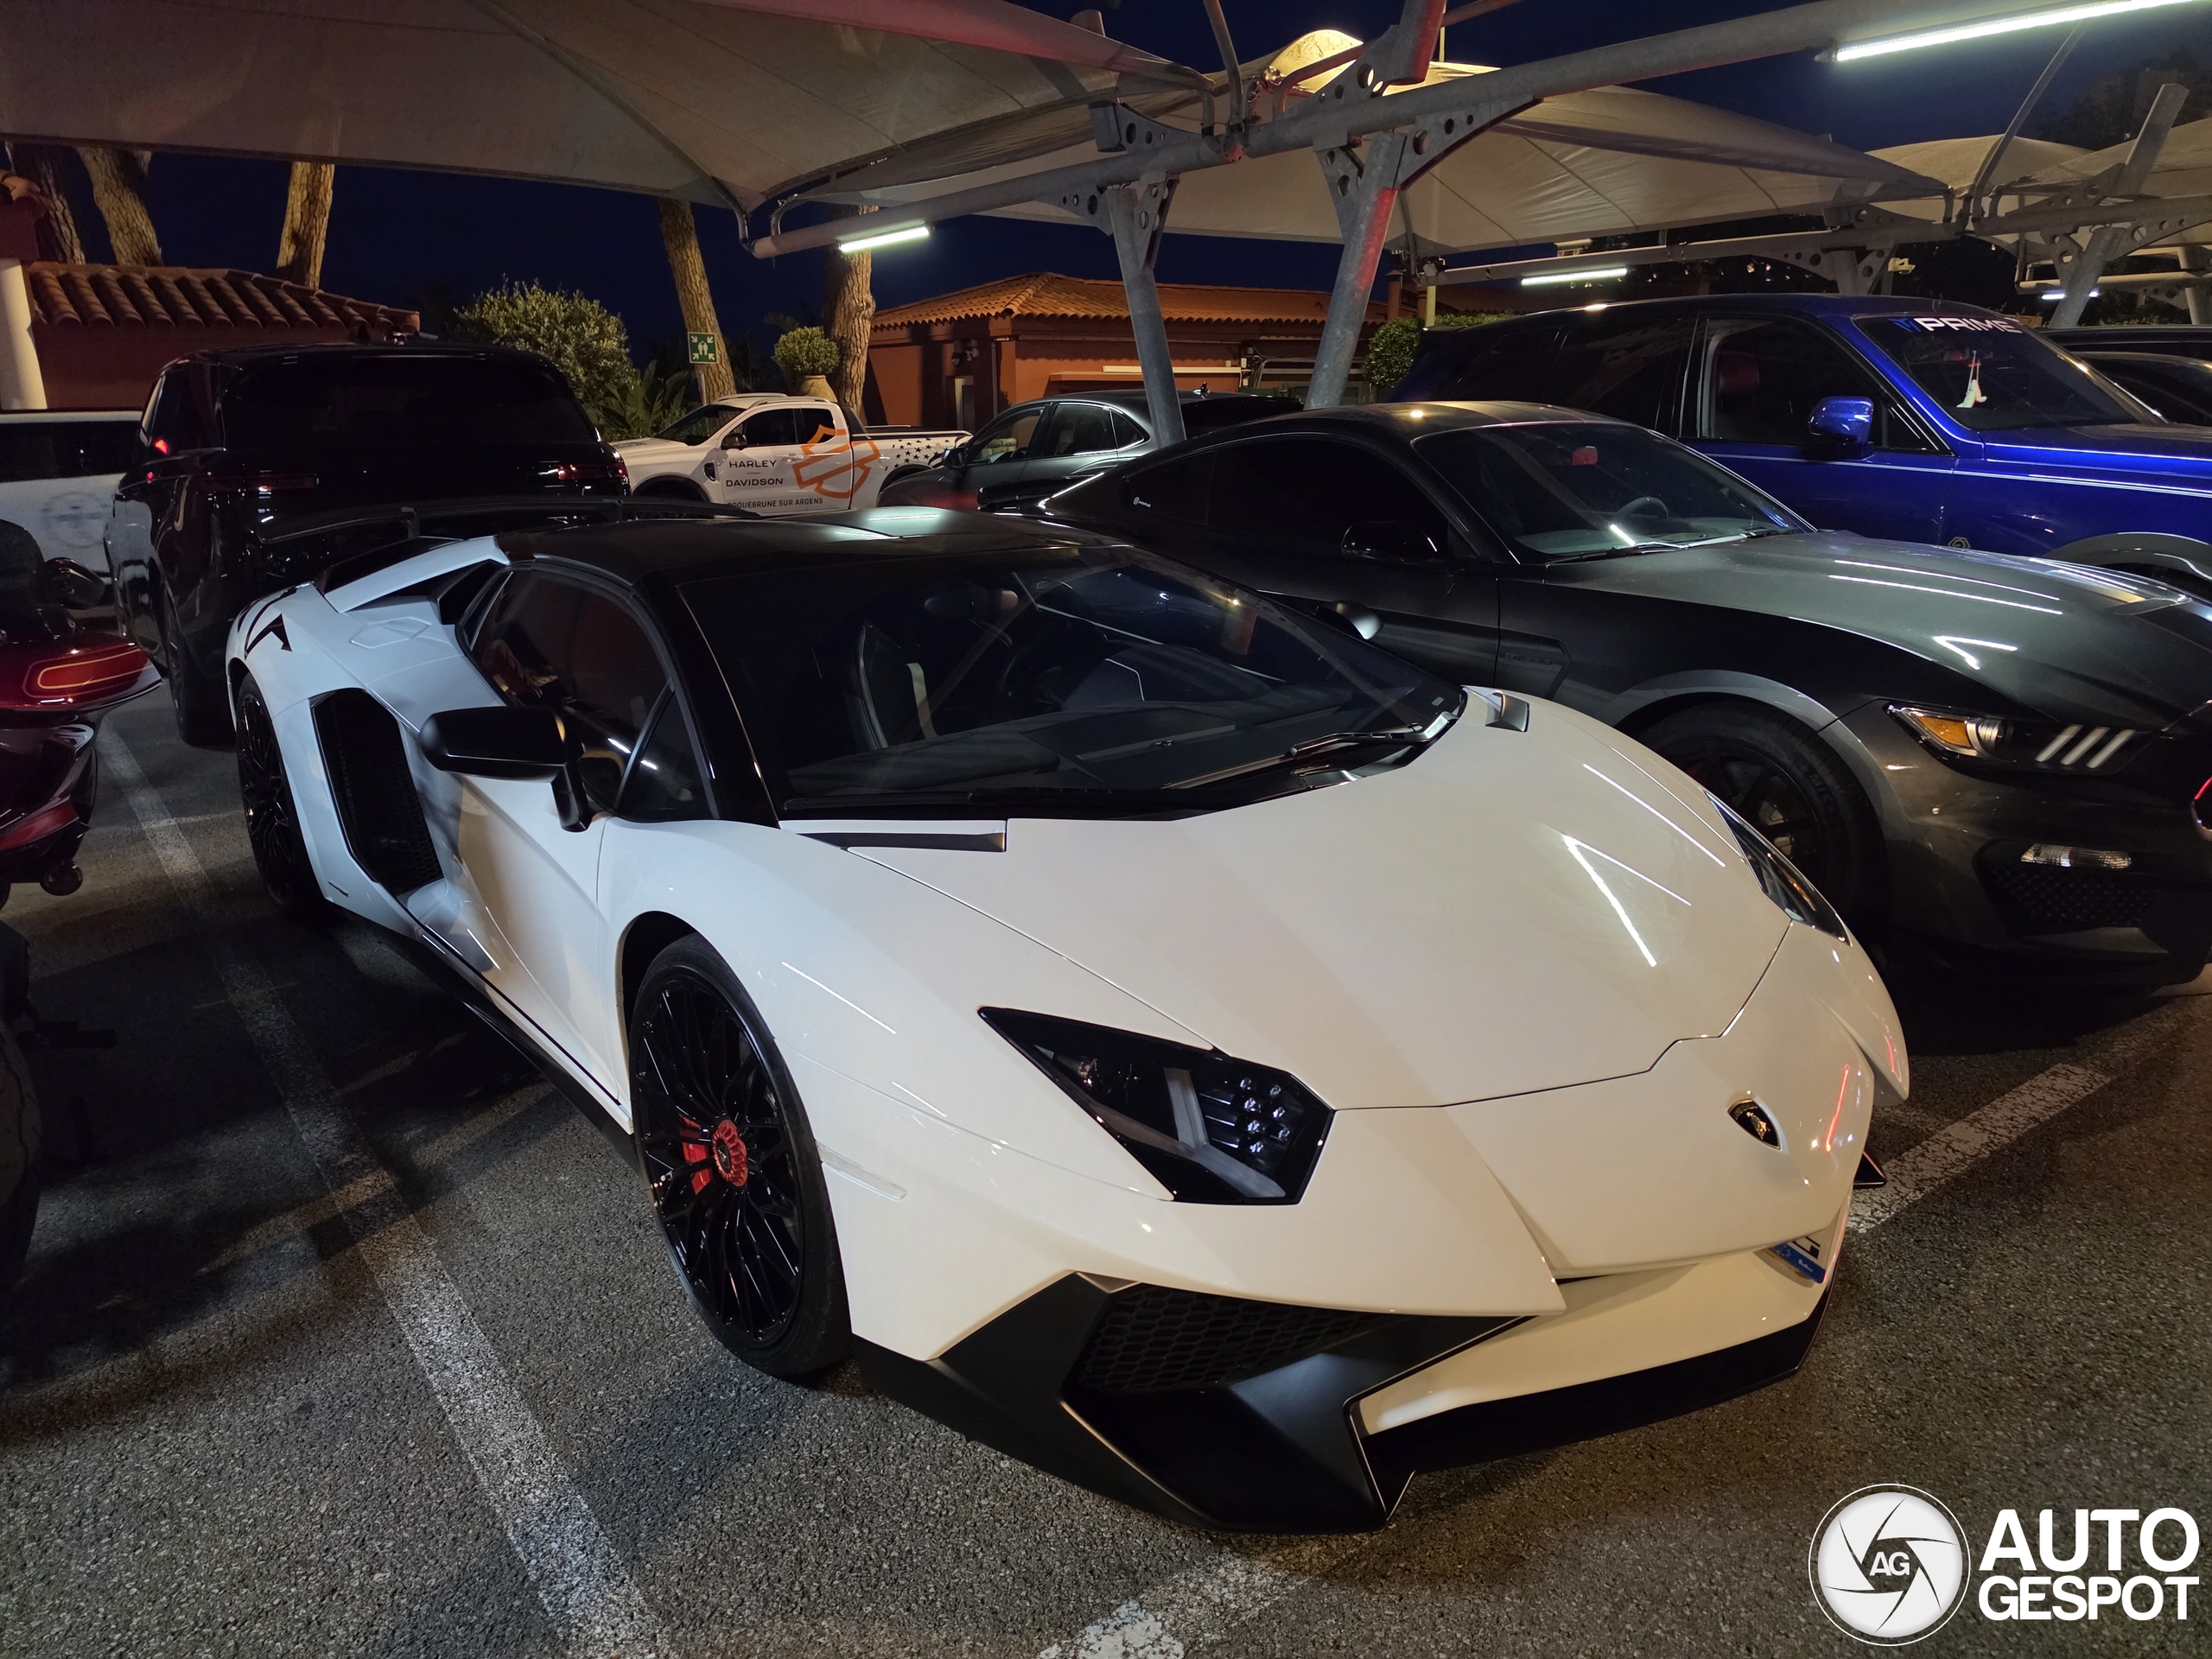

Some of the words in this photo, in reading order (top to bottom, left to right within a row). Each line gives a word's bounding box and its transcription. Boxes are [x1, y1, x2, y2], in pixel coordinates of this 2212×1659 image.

[1914, 317, 2023, 334] PRIME
[728, 460, 777, 468] HARLEY
[726, 478, 784, 487] DAVIDSON
